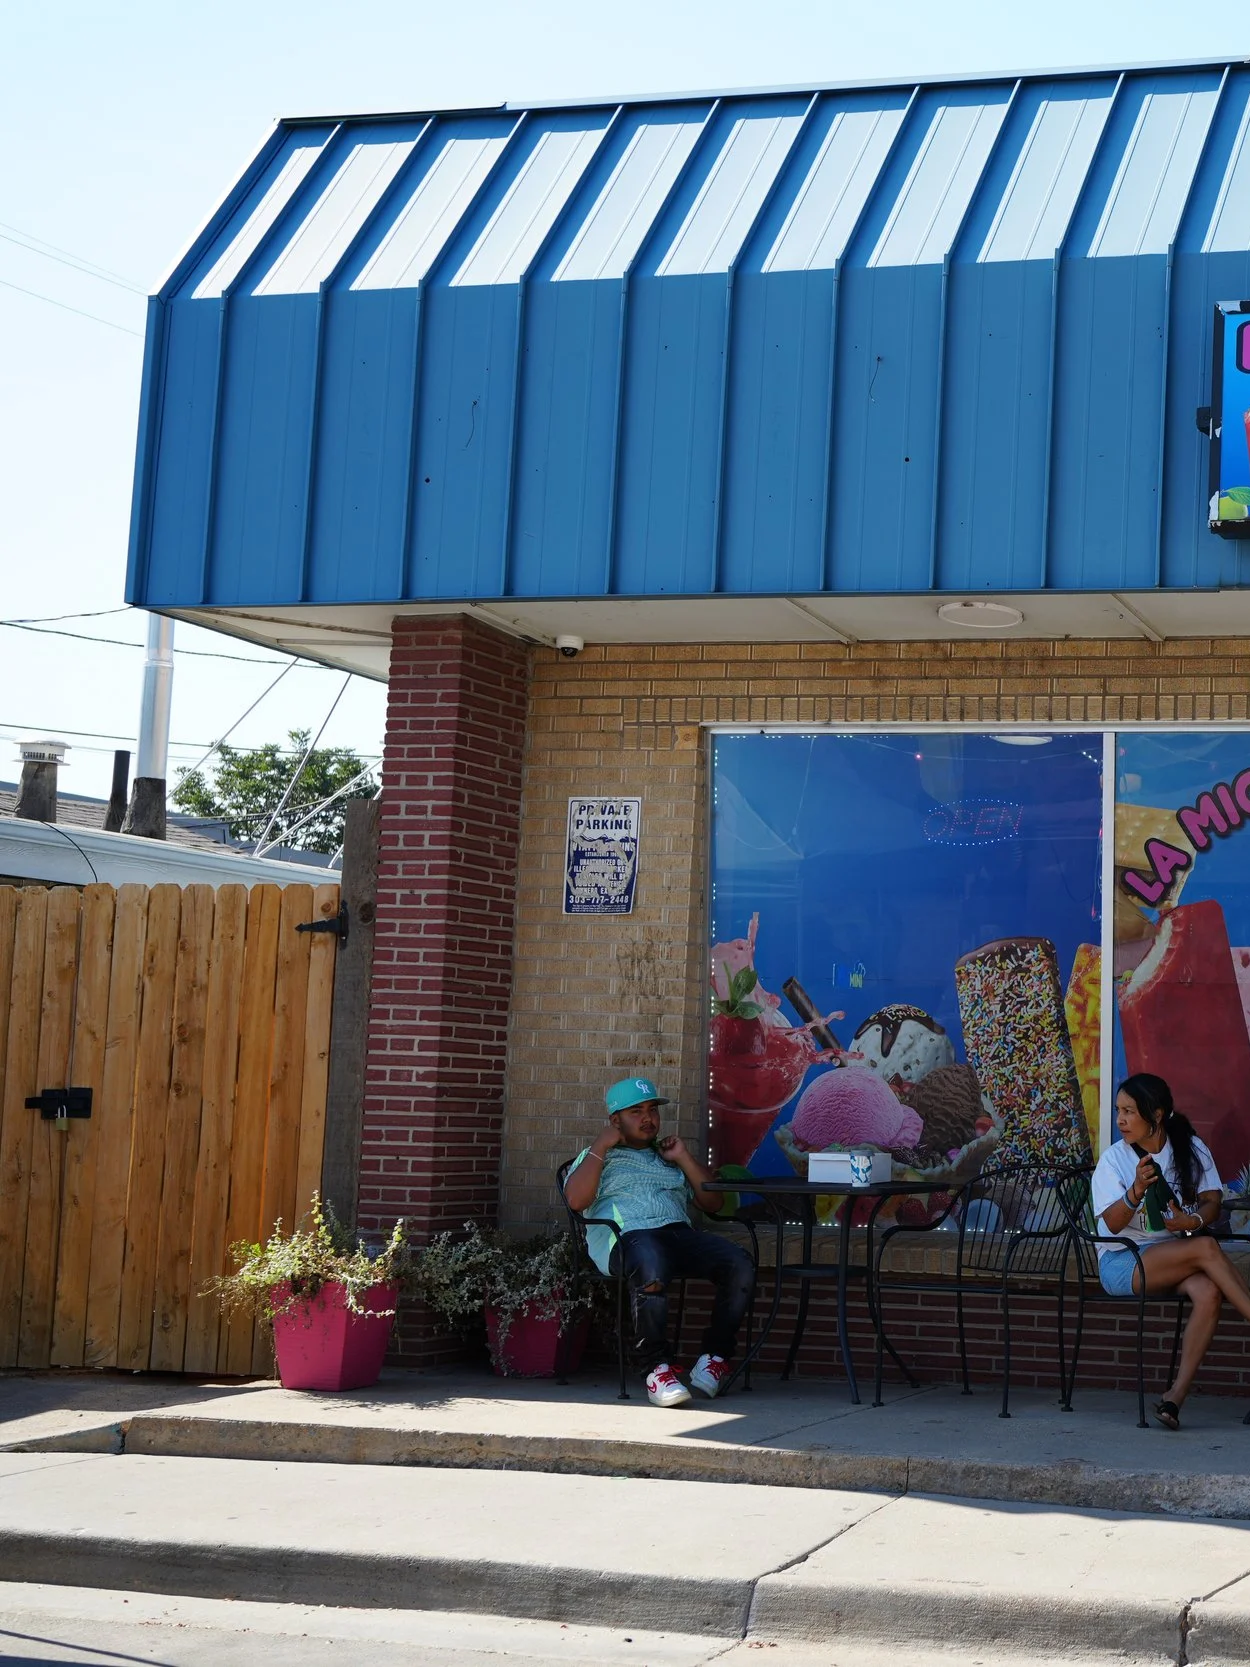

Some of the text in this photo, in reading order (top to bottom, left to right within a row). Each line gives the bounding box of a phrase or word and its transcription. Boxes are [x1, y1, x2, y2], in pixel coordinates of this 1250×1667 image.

[923, 805, 1024, 837] OPEN
[1122, 838, 1193, 907] LA
[635, 1080, 652, 1094] CR
